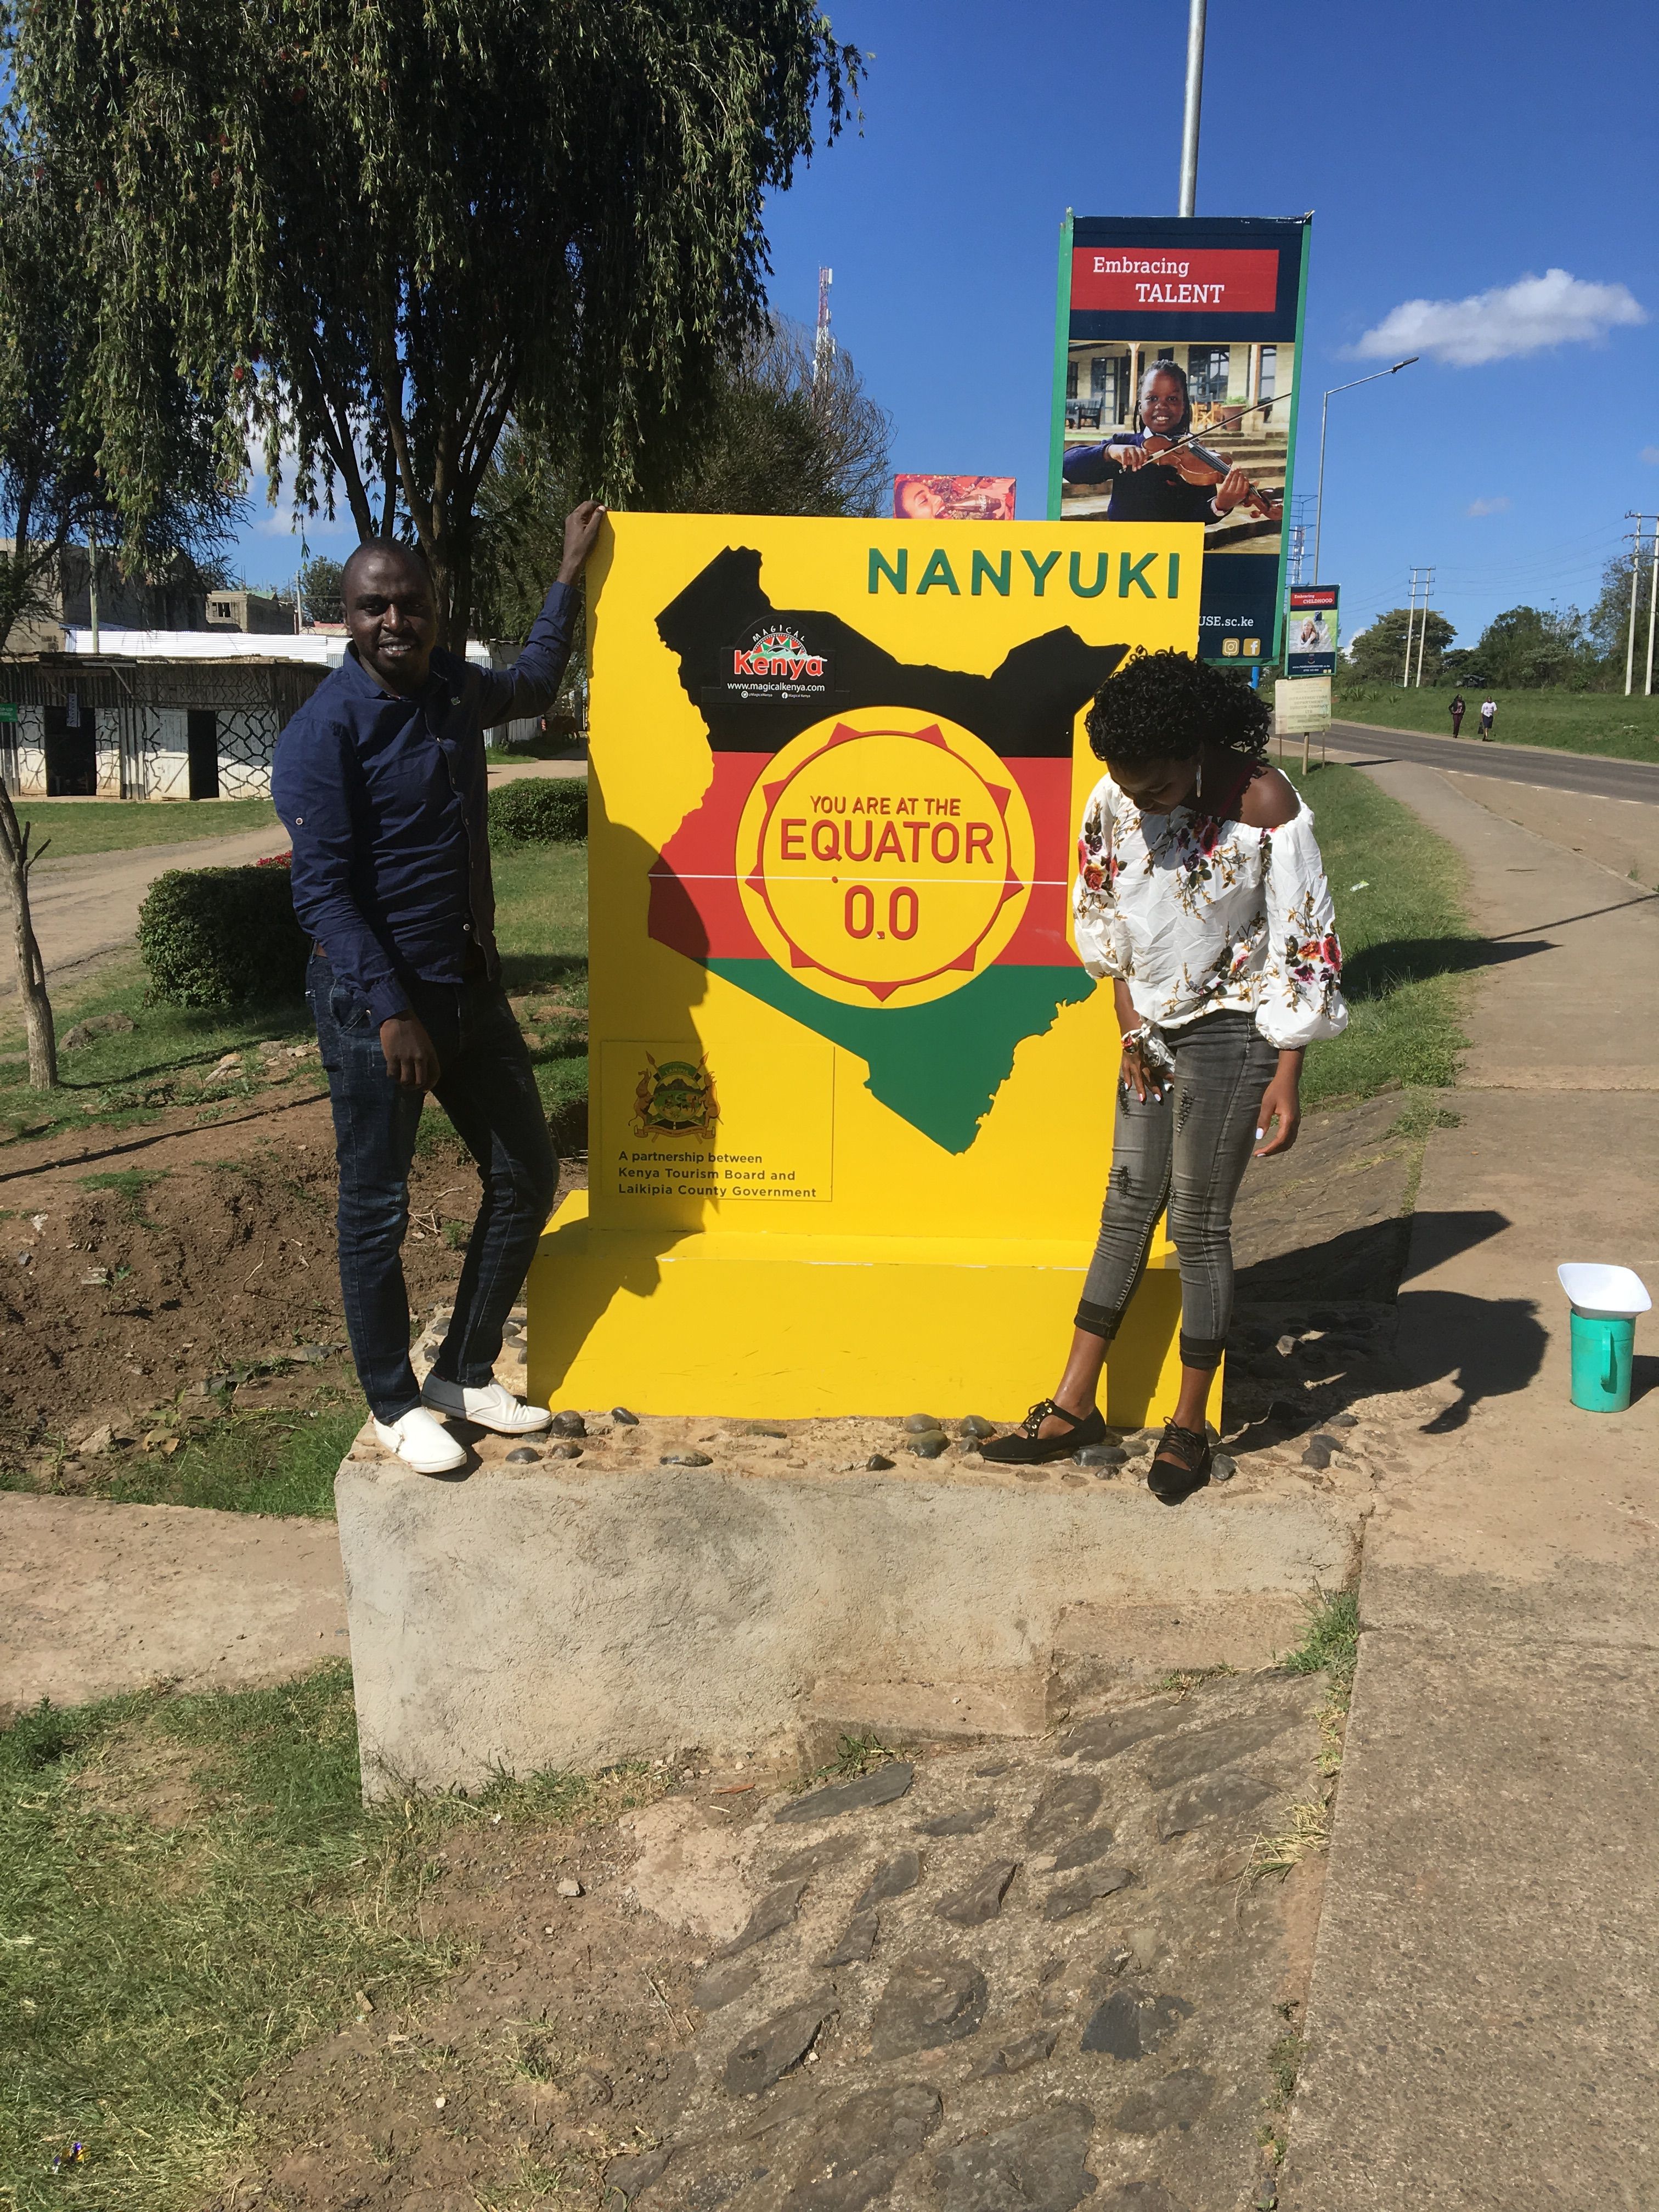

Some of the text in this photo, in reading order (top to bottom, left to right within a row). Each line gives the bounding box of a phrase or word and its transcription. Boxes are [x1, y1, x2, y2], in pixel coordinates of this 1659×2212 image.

[1093, 256, 1190, 277] Embracing
[1135, 283, 1225, 303] TALENT
[868, 548, 1180, 599] NANYUKI
[752, 624, 805, 642] MAGICAL
[733, 650, 824, 680] Kenya
[727, 682, 825, 693] www.magicalkenya.com
[810, 795, 962, 816] YOU ARE AT THE
[781, 819, 995, 865] EQUATOR
[844, 884, 919, 941] 0.0
[618, 1151, 763, 1164] A partnership between
[619, 1167, 795, 1181] Kenya Tourism Board and
[619, 1184, 816, 1198] Laikipia County Government
